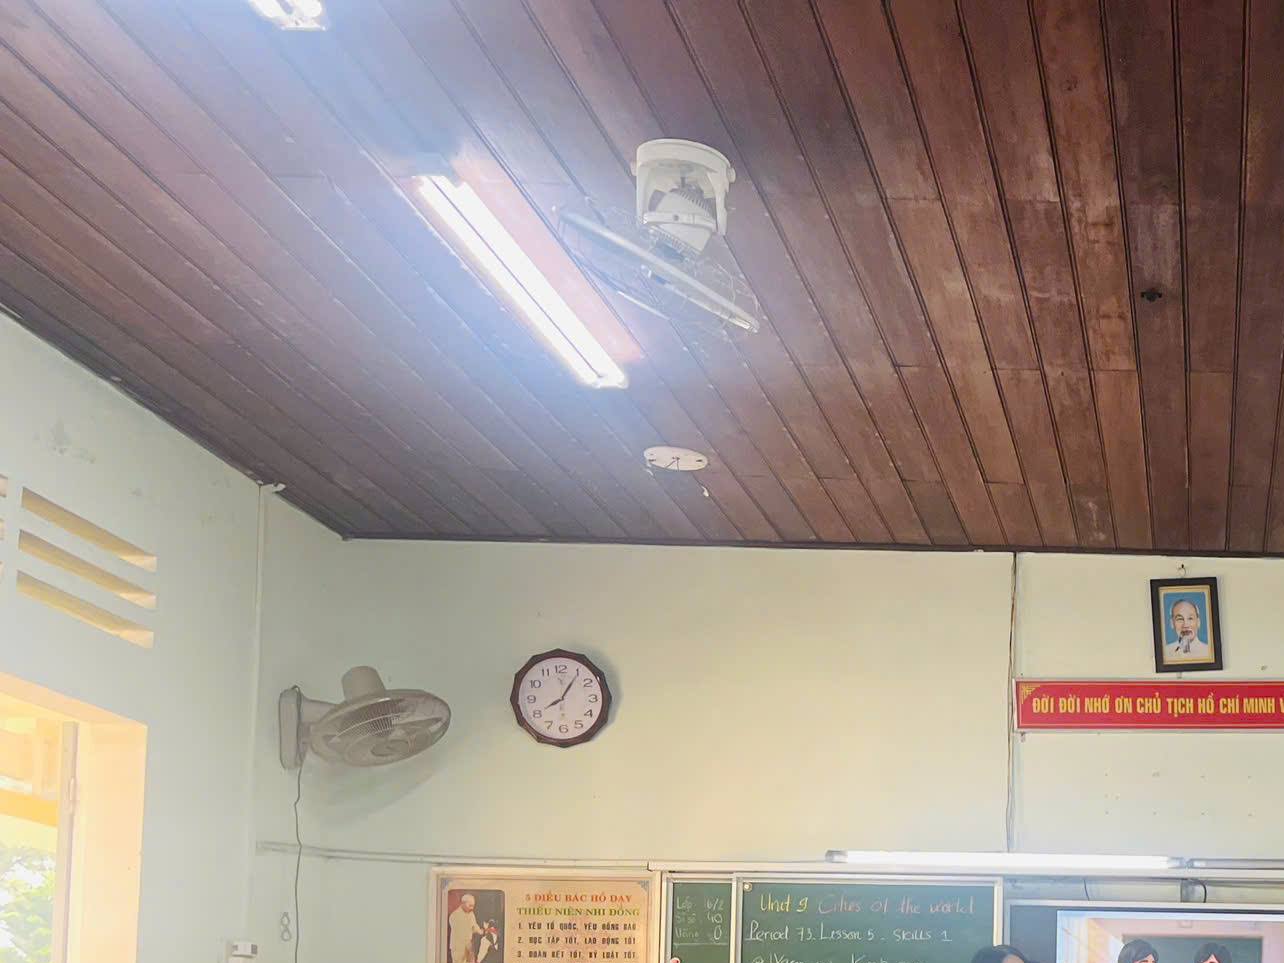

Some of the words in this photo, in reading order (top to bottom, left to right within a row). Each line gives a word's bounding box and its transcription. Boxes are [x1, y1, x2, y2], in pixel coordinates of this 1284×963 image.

[541, 668, 550, 677] 11
[554, 664, 568, 674] 12
[529, 680, 542, 689] 10
[583, 678, 593, 688] 2
[527, 695, 536, 704] 9
[588, 694, 598, 703] 3
[1032, 694, 1054, 714] ĐỜI
[1059, 694, 1080, 714] ĐỜI
[1084, 694, 1110, 714] NHỚ
[1115, 695, 1132, 714] ƠN
[1136, 692, 1161, 714] CHỦ
[1166, 697, 1194, 717] TỊCH
[1197, 692, 1215, 714] HỒ
[1219, 694, 1240, 714] CHÍ
[1243, 697, 1276, 714] MINH
[533, 709, 543, 718] 8
[584, 709, 593, 718] 4
[544, 720, 553, 730] 7
[558, 724, 569, 734] 6
[574, 719, 584, 729] 5
[760, 893, 791, 912] Unit
[796, 896, 809, 912] 9
[900, 895, 921, 914] the
[928, 895, 976, 914] world
[585, 908, 606, 916] NHI
[713, 924, 723, 941] 0
[744, 919, 789, 941] Period
[820, 921, 863, 940] Lesson
[867, 929, 875, 941] 5
[940, 929, 953, 942] 1
